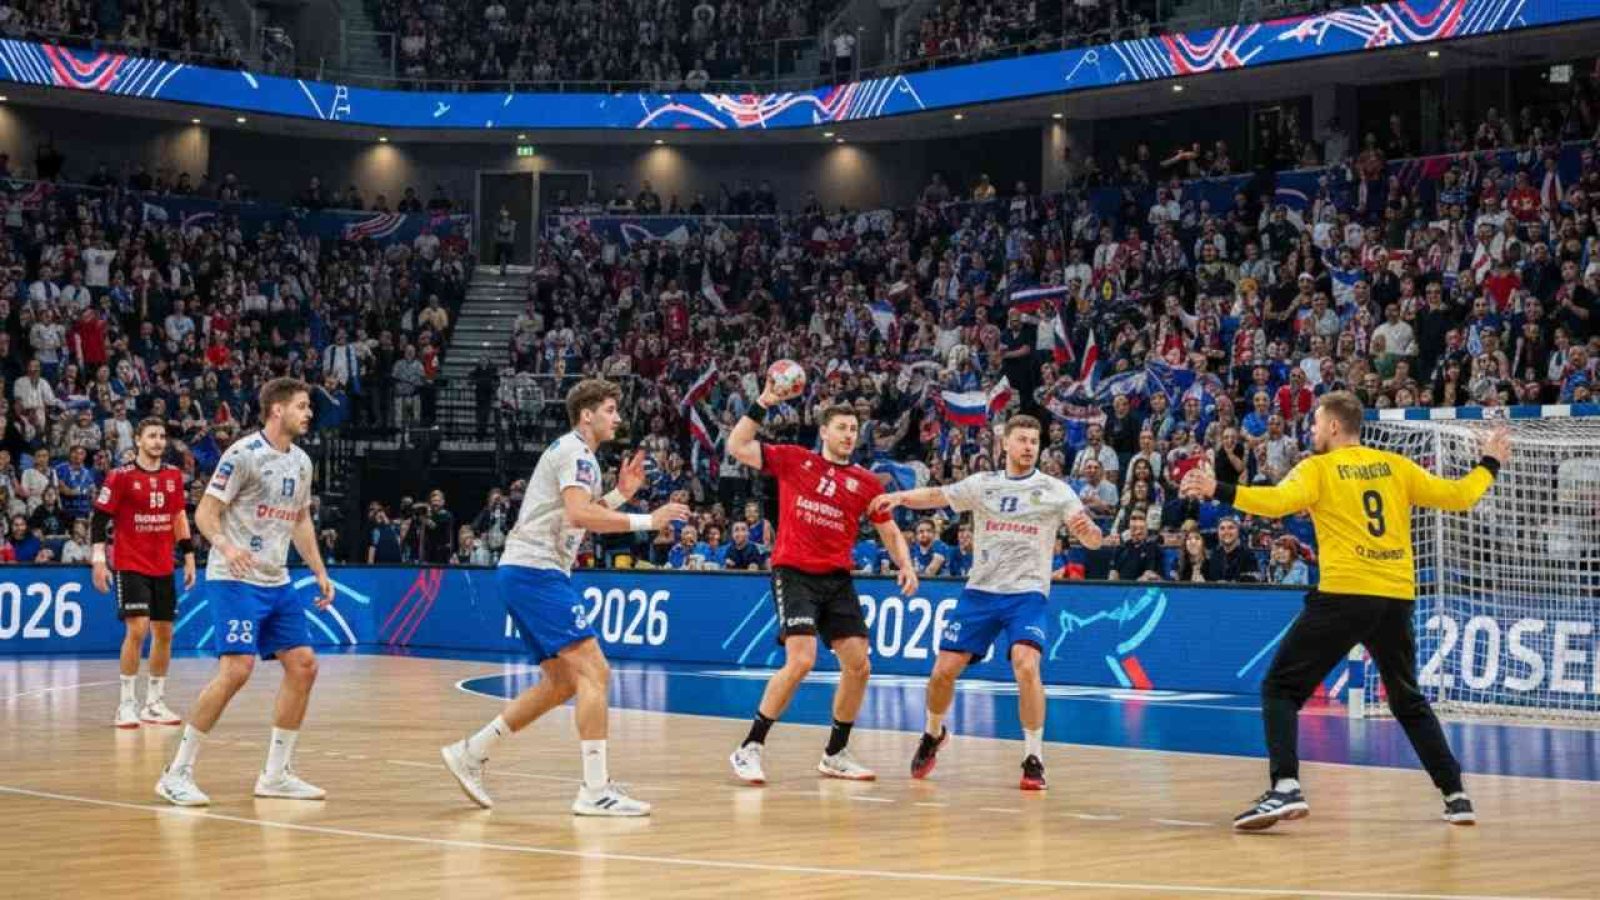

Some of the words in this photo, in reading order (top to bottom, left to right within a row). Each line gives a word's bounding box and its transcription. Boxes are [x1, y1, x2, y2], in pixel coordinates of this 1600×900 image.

[1363, 490, 1386, 537] 9
[0, 582, 82, 638] 026
[583, 587, 671, 645] 2026
[1417, 615, 1600, 692] 20SE
